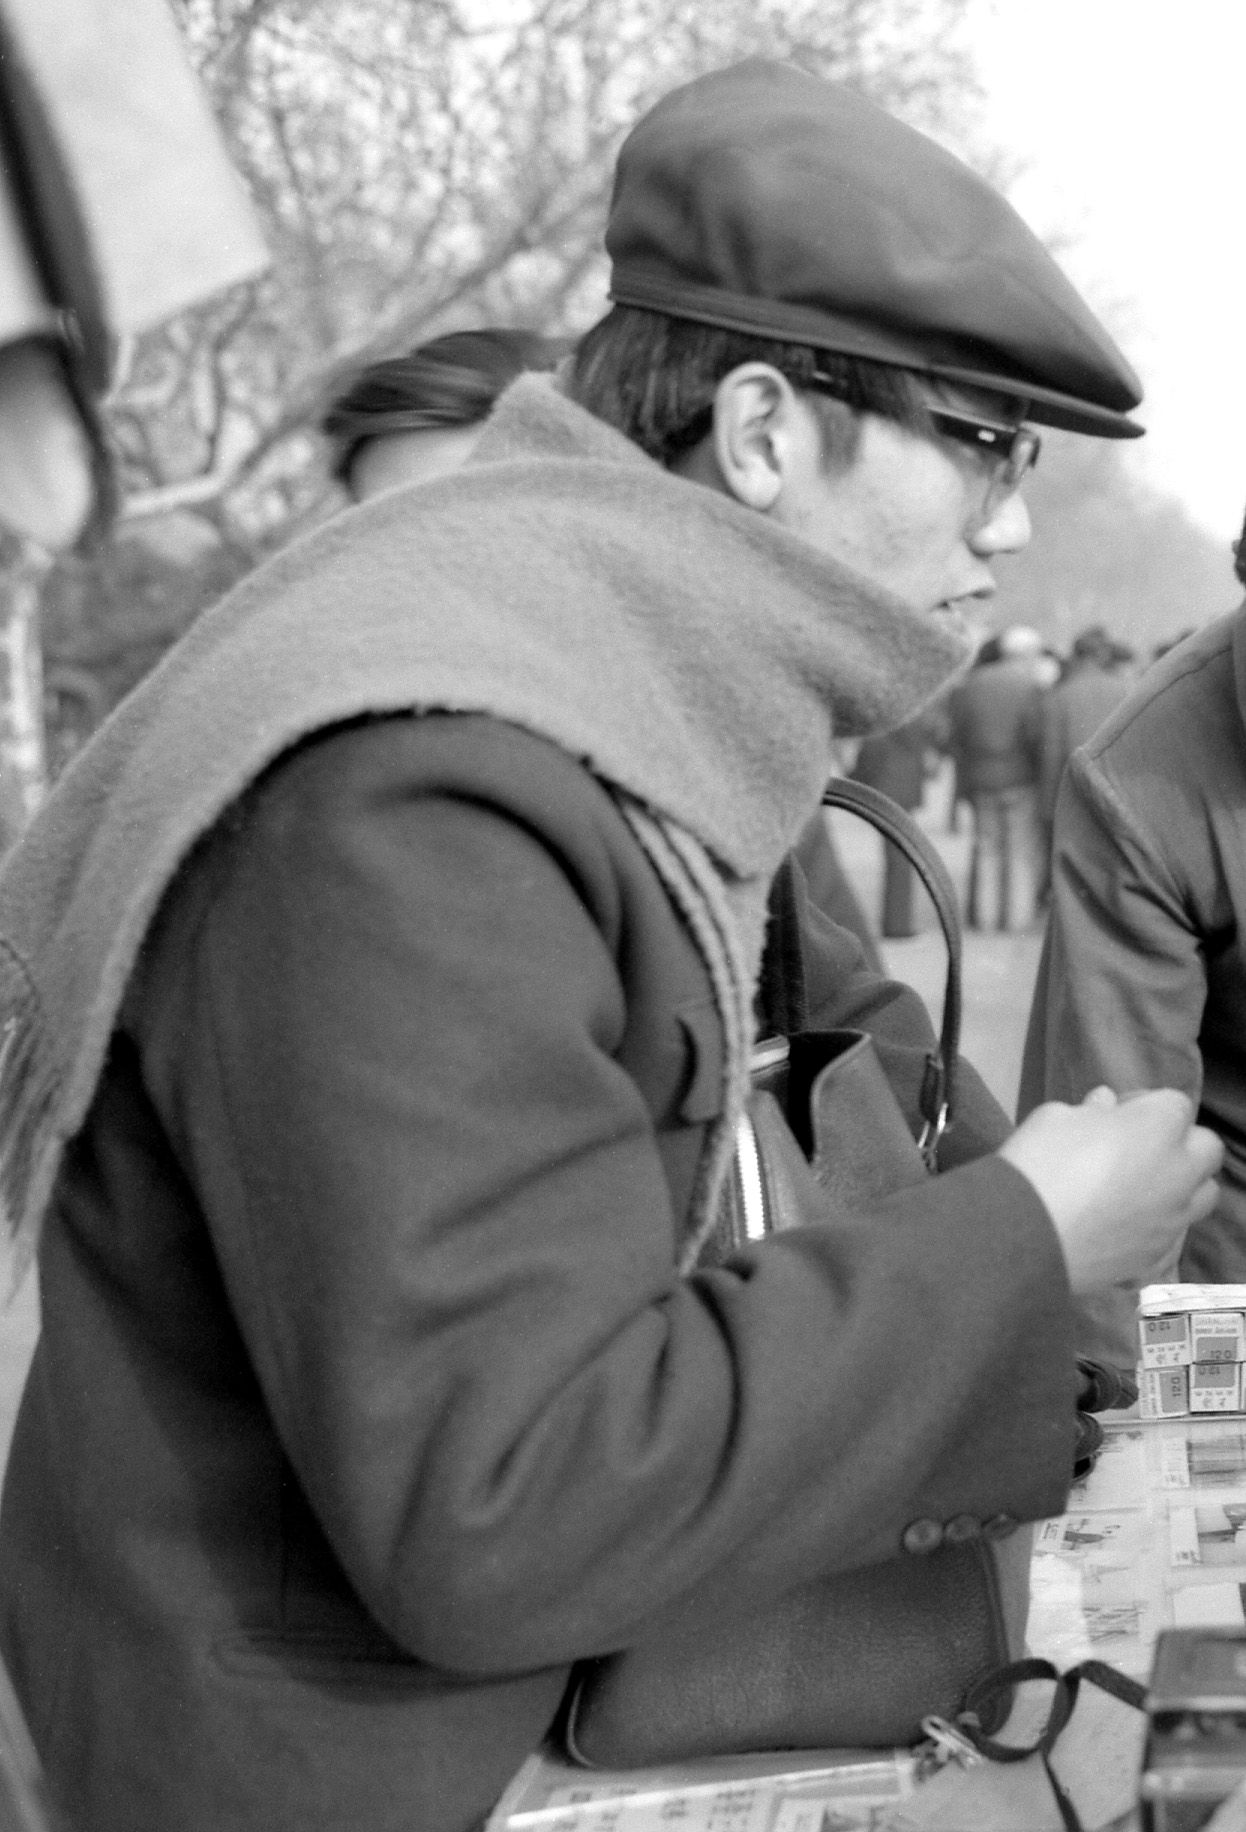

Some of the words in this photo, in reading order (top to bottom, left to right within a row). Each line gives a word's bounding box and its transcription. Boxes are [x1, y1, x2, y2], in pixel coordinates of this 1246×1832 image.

[1149, 1320, 1171, 1332] 120
[1210, 1350, 1233, 1360] 120
[1171, 1376, 1182, 1397] 120
